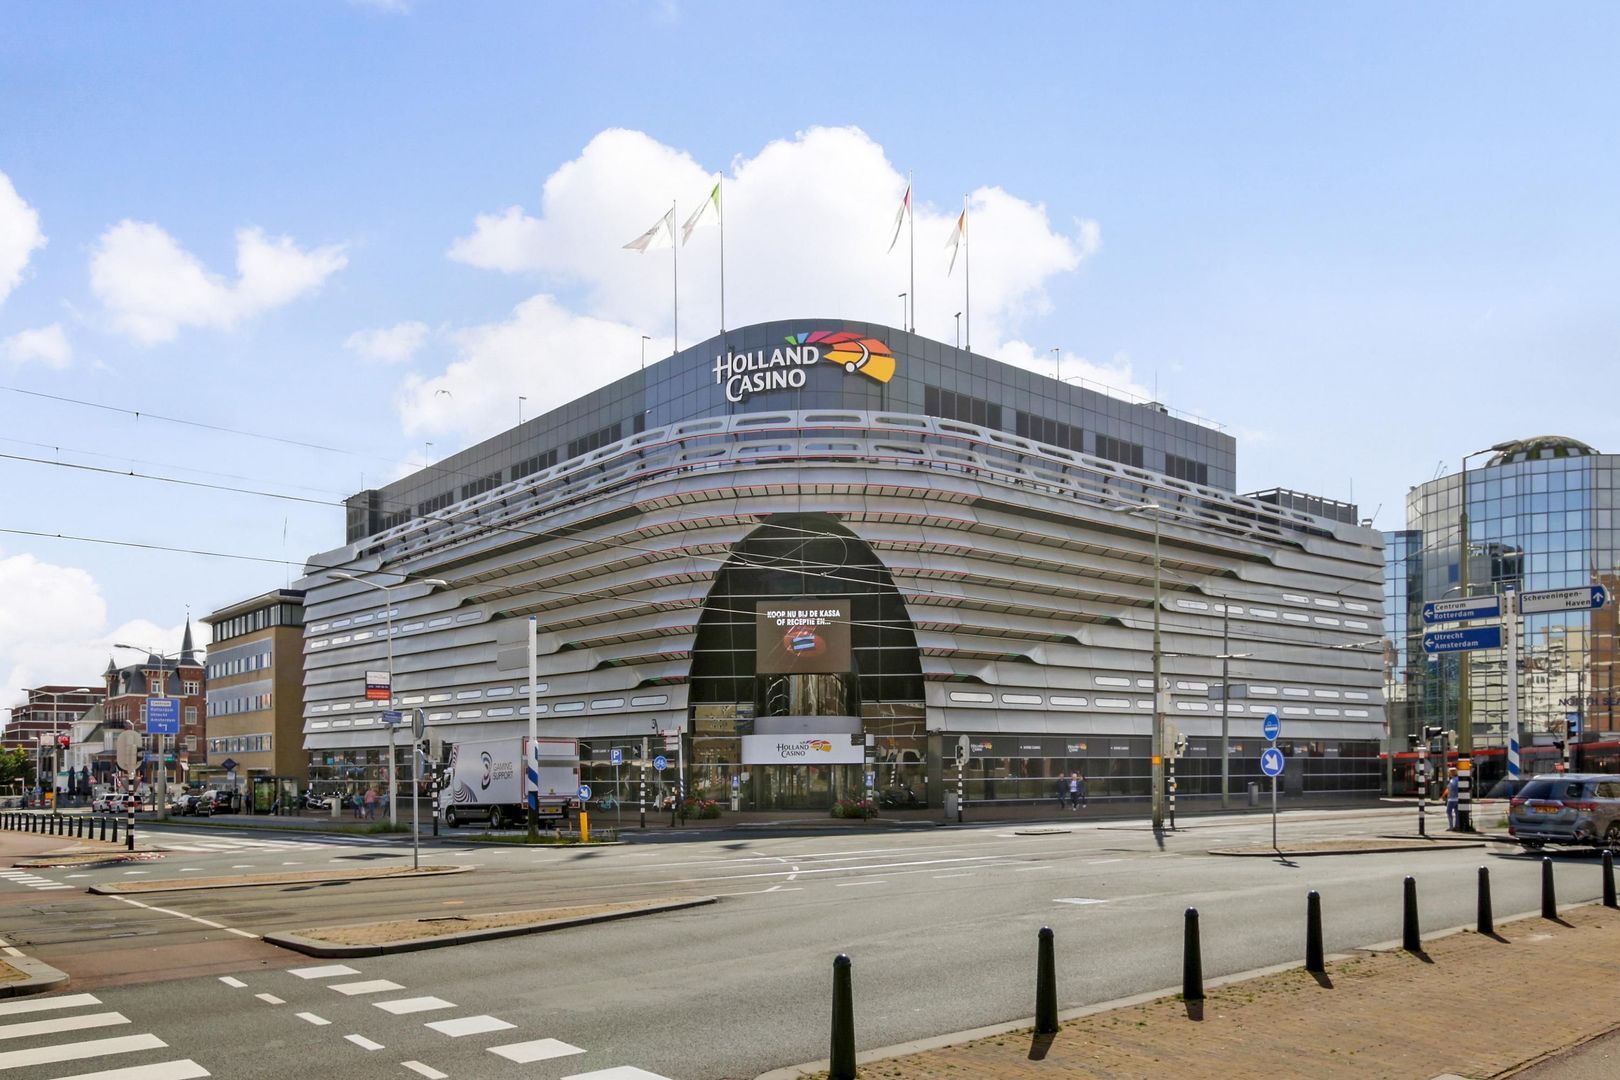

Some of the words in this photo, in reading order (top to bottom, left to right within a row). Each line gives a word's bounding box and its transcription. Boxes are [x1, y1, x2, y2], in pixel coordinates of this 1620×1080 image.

[712, 346, 820, 385] HOLLAND
[725, 368, 806, 402] CASINO
[1523, 591, 1583, 602] Scheveningen-
[1435, 602, 1466, 611] Centrum
[767, 610, 786, 618] KOOP
[787, 610, 797, 618] NU
[798, 610, 808, 618] BIJ
[819, 609, 841, 617] KASSA
[1434, 610, 1475, 619] Rotterdam
[776, 618, 786, 626] OF
[1434, 632, 1464, 641] Utrecht
[1434, 640, 1479, 649] Amsterdam
[776, 743, 809, 752] HOLLAND
[613, 751, 620, 759] P
[781, 750, 806, 758] CASINO
[492, 761, 513, 771] GAMING
[492, 771, 514, 780] SUPPORT
